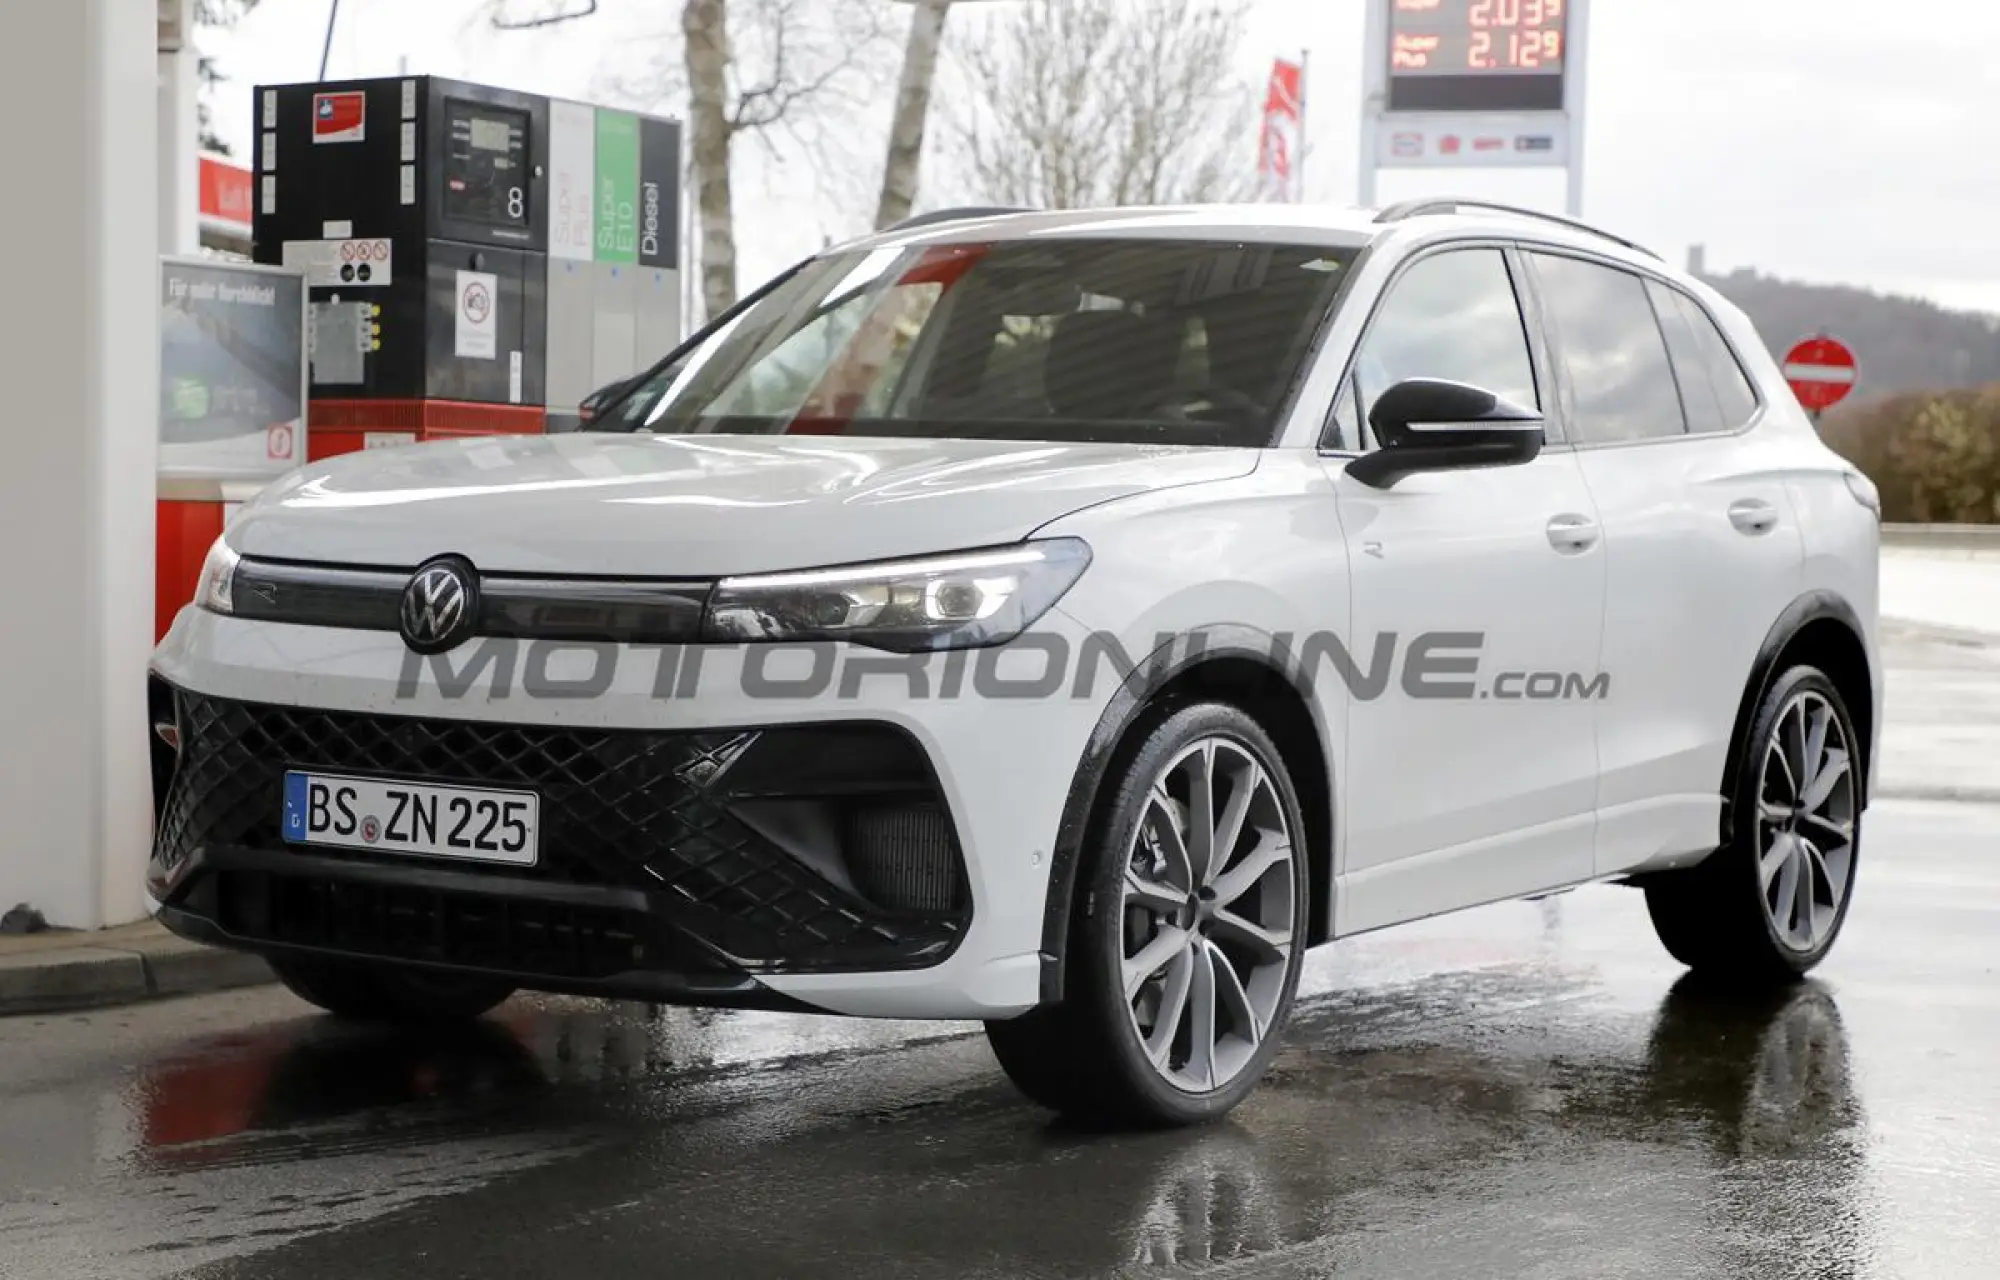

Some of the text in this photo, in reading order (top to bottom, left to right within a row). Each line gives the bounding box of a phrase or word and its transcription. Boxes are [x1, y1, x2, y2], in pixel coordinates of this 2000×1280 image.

[508, 186, 523, 218] 8
[598, 174, 616, 249] Super
[616, 201, 634, 252] E10
[641, 182, 659, 256] Diesel
[308, 783, 528, 852] BS ZN 225
